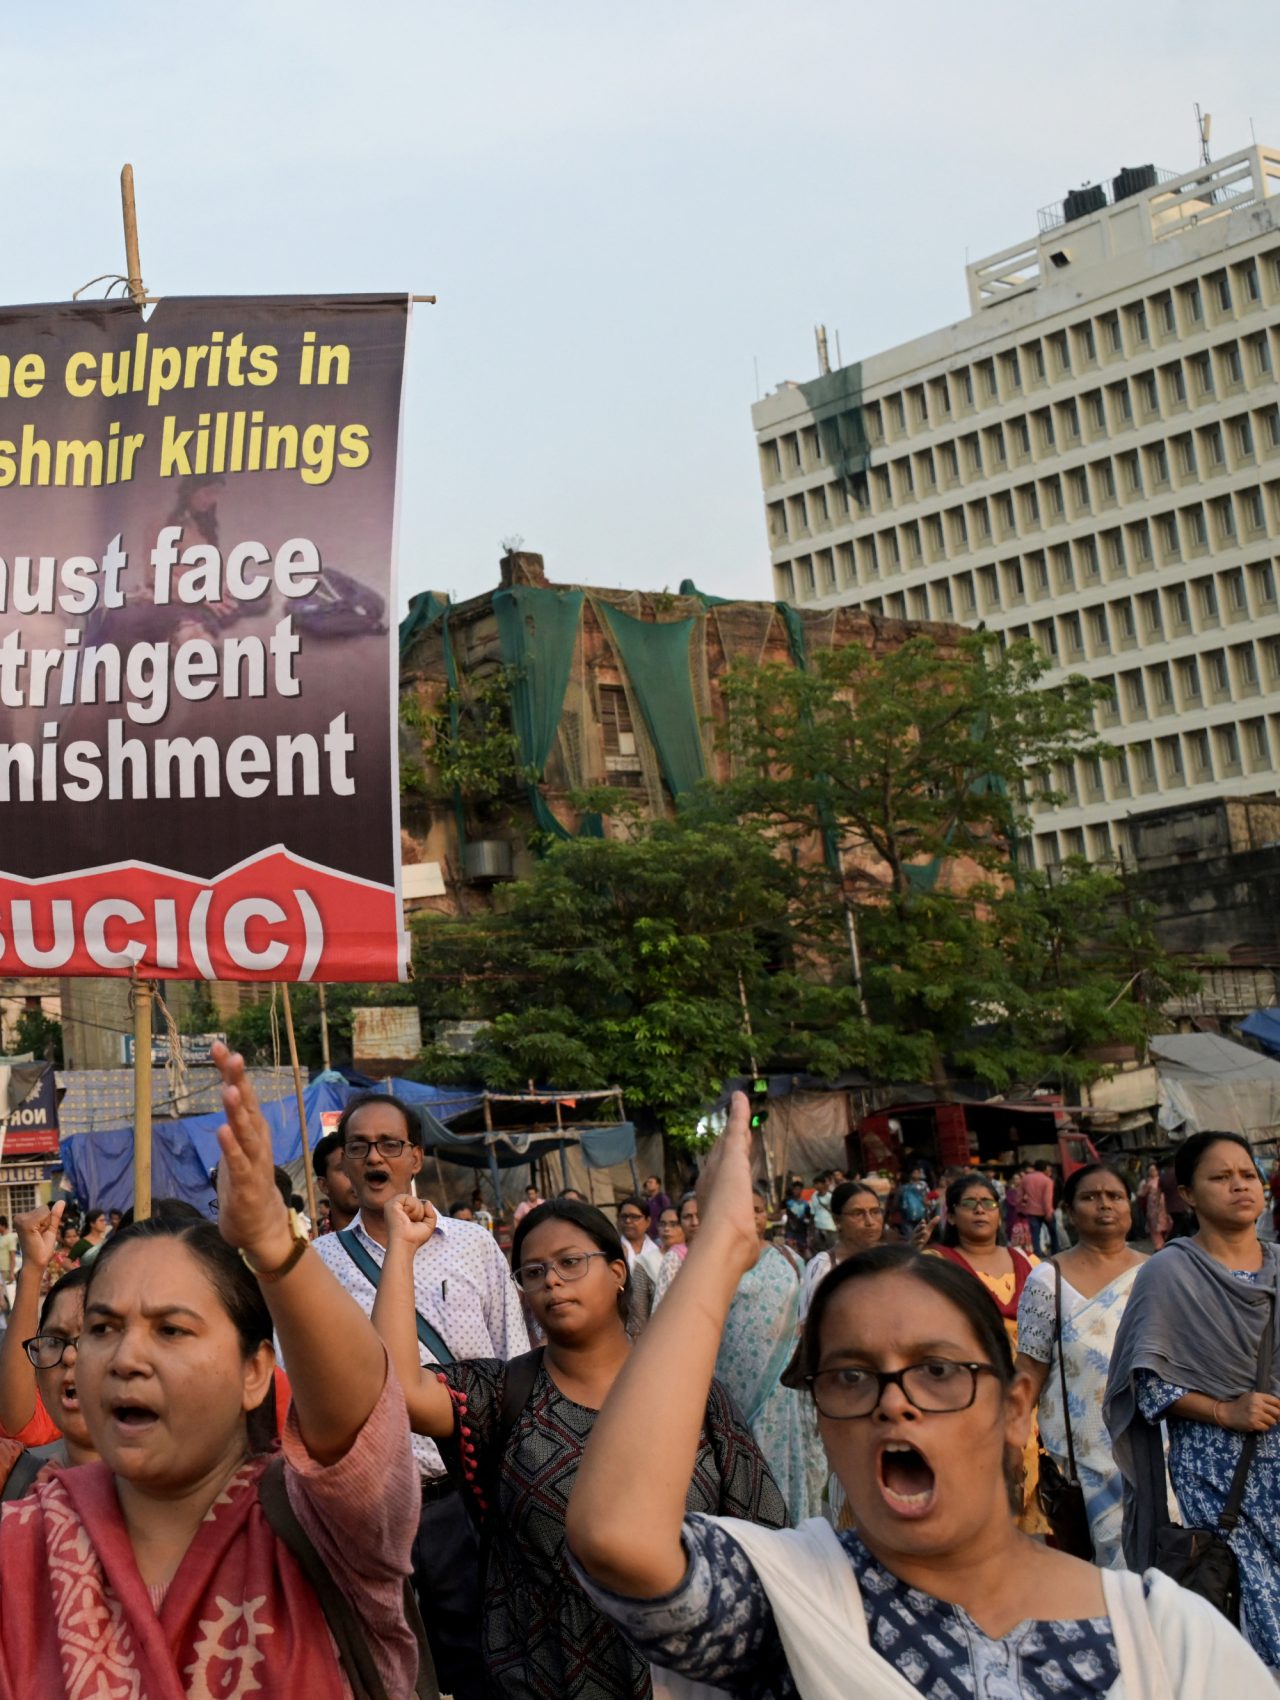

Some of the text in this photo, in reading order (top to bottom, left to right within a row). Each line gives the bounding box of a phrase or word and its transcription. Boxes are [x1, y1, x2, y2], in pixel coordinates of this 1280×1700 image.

[64, 331, 279, 406] culprits
[300, 331, 351, 386] in
[159, 411, 372, 485] killings
[151, 525, 322, 606] face
